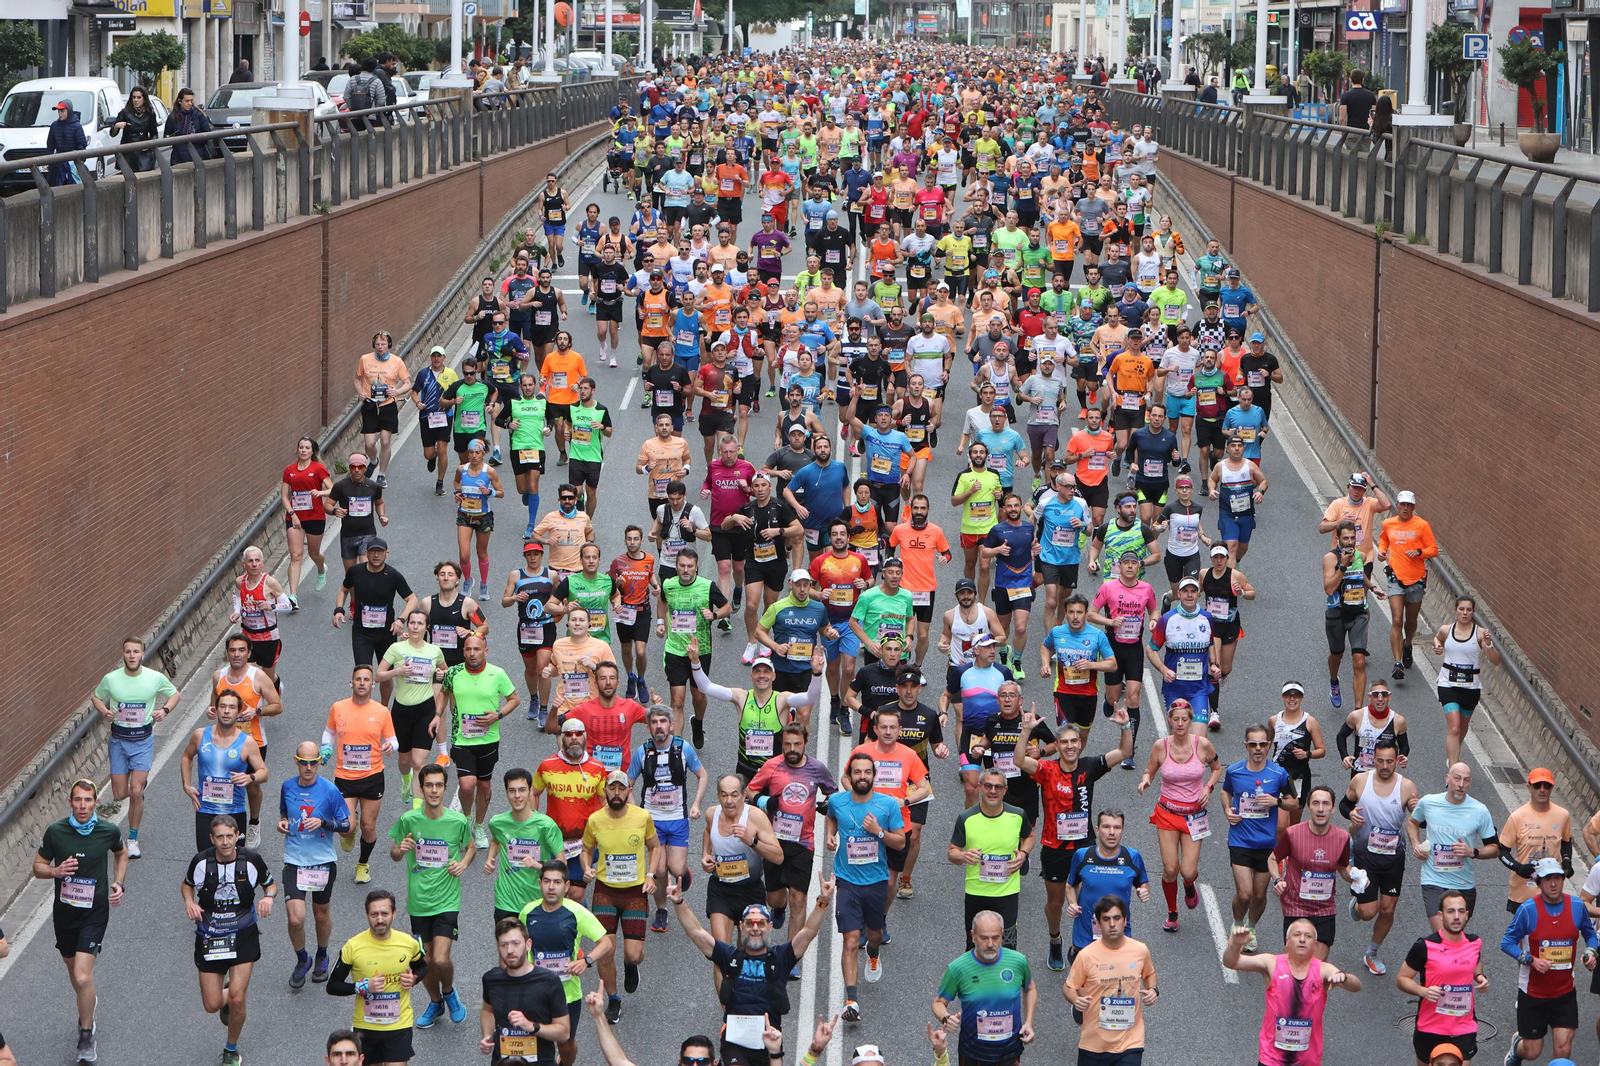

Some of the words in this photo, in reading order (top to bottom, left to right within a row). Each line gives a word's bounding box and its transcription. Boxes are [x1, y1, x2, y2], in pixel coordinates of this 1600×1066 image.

[1469, 38, 1484, 57] P
[715, 479, 739, 487] QATAR
[909, 537, 926, 550] als
[1118, 600, 1141, 608] Triatlón
[547, 782, 573, 793] ANSIA
